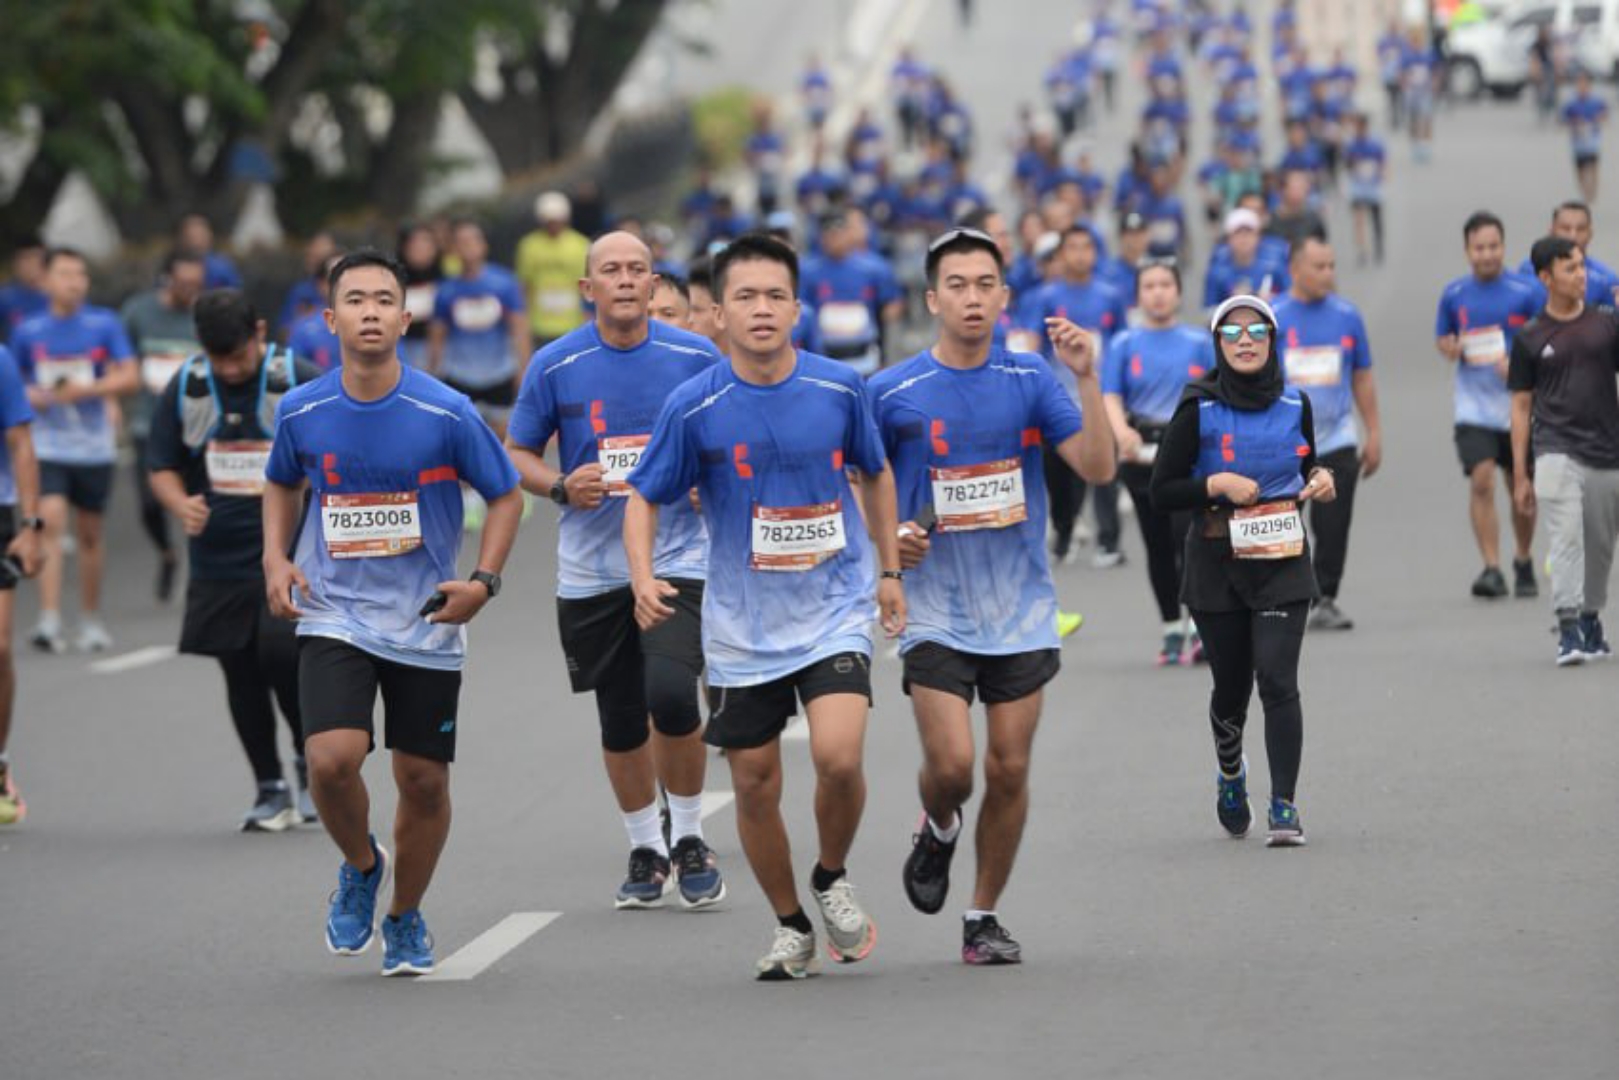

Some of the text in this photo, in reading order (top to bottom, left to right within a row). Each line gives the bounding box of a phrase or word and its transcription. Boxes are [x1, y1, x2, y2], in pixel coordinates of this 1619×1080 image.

[944, 477, 1014, 502] 7822741
[329, 510, 412, 528] 7823008
[1240, 516, 1296, 536] 7821961
[760, 520, 837, 542] 7822563
